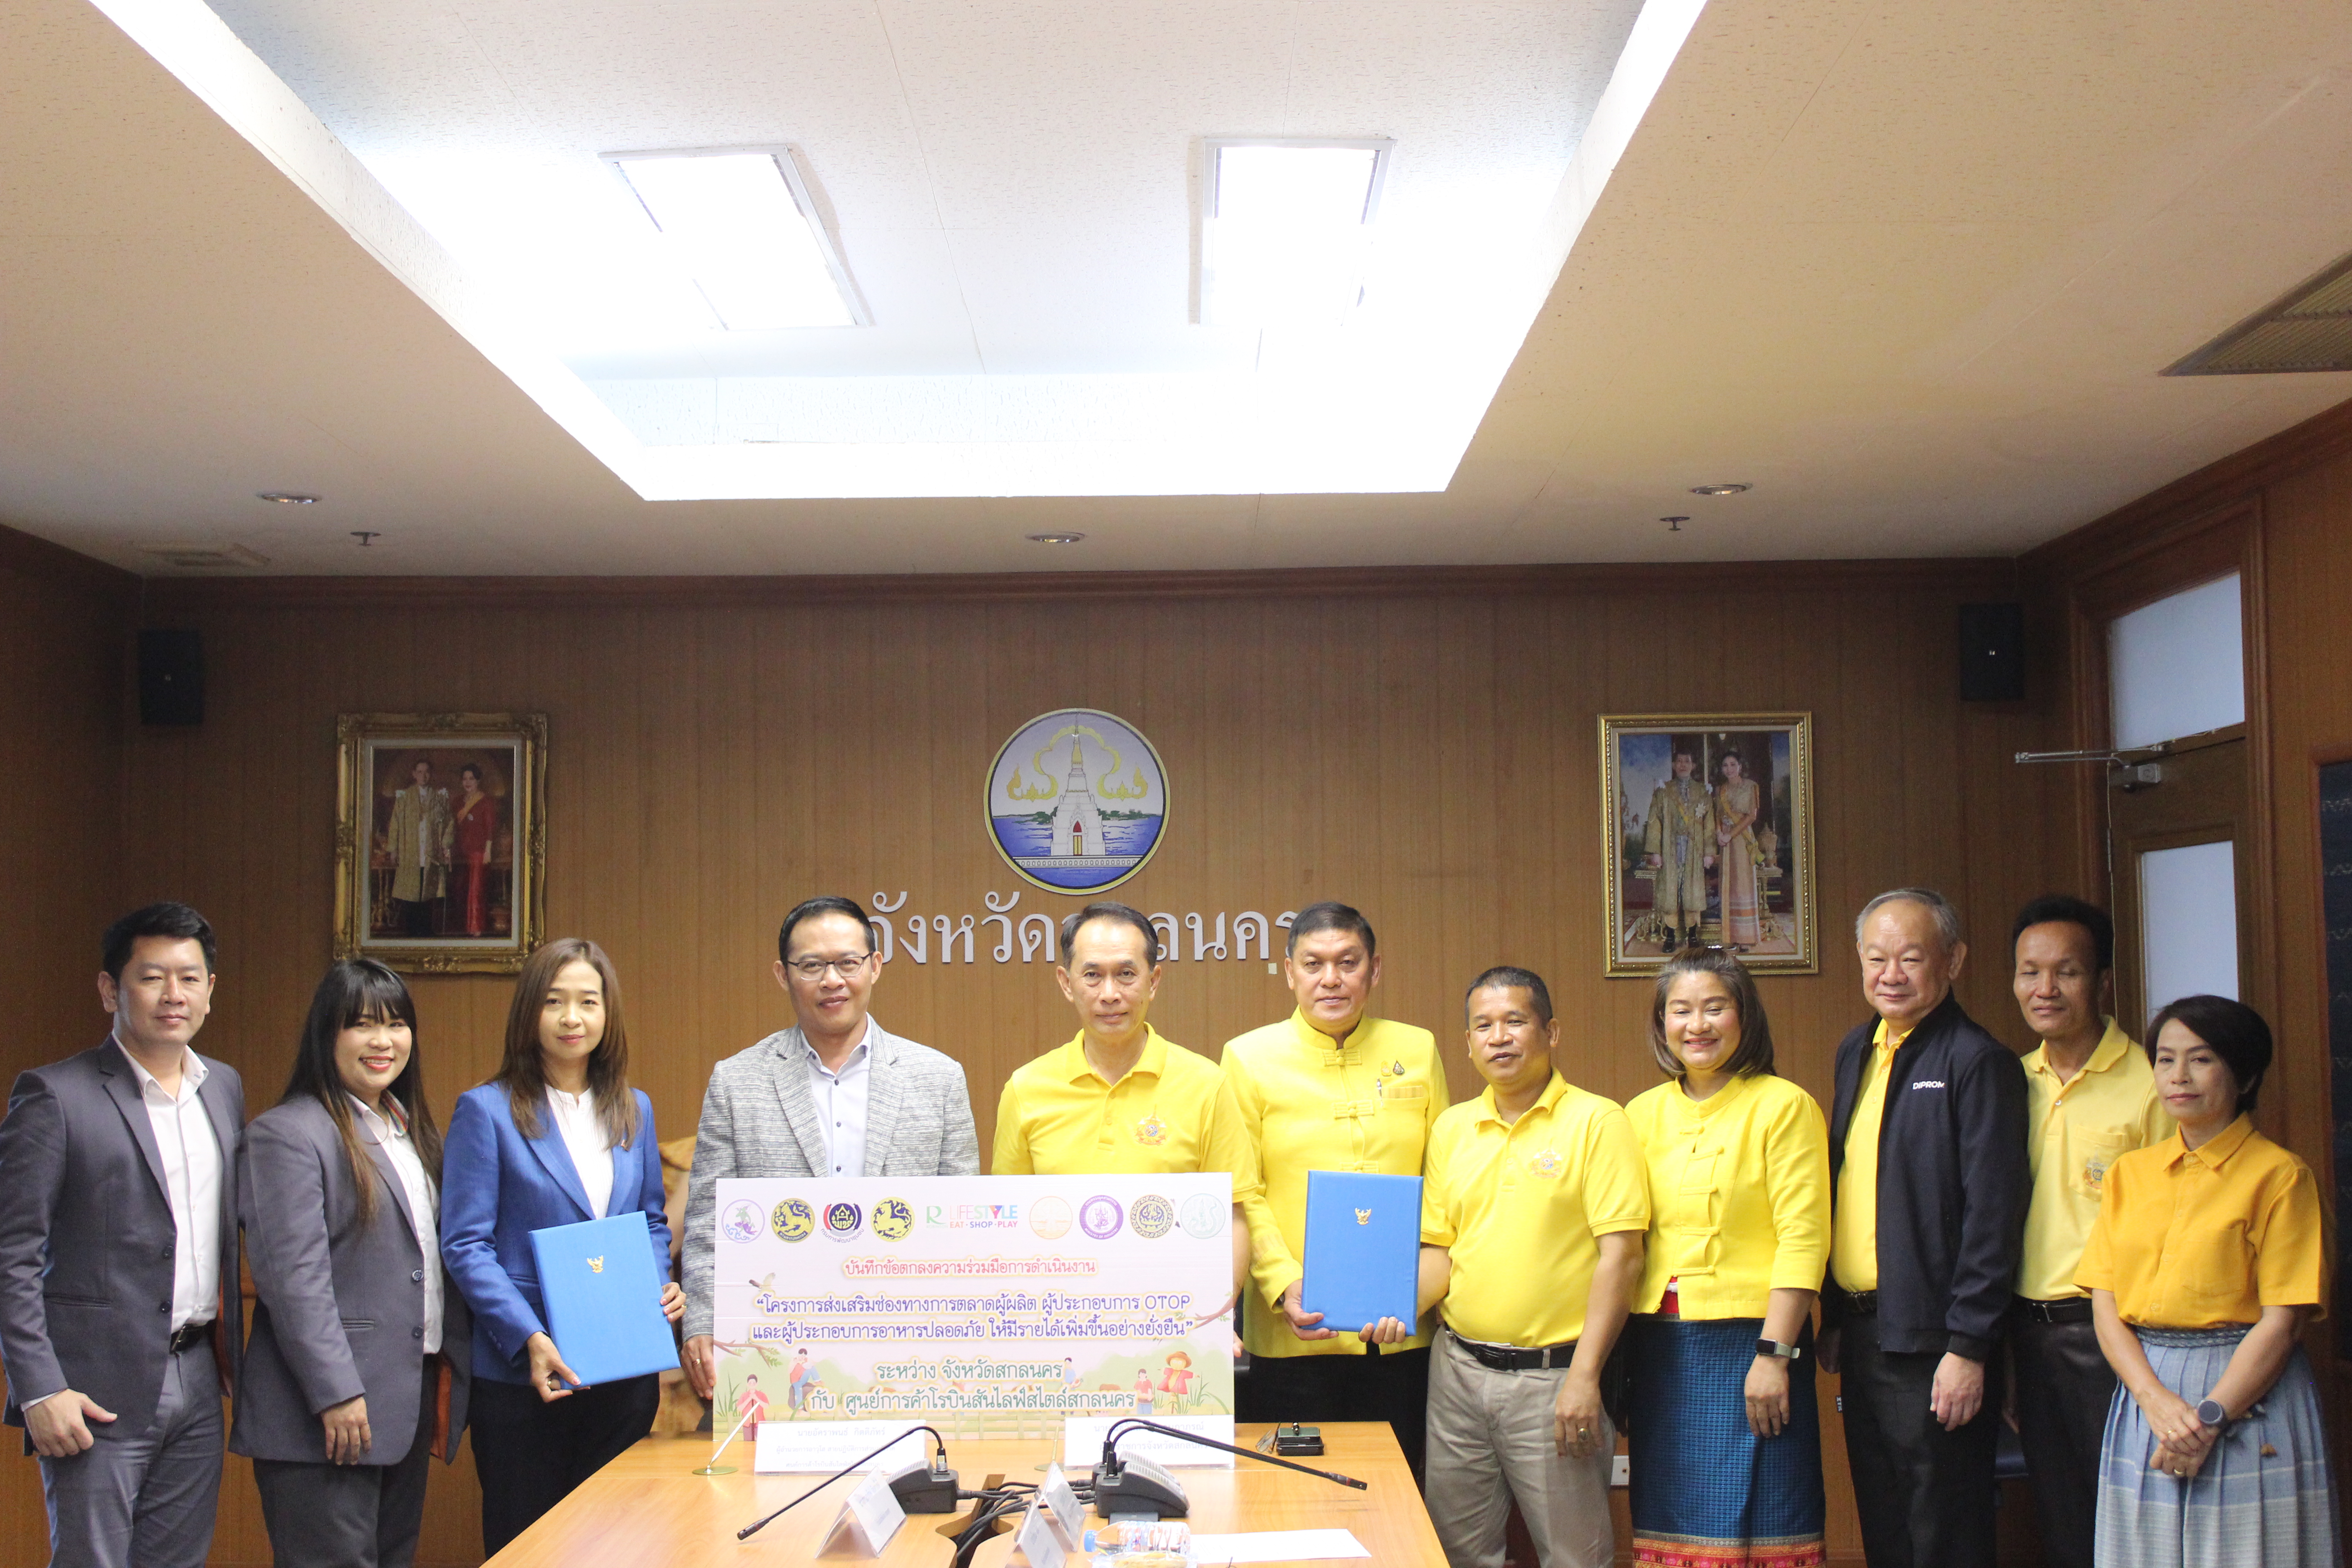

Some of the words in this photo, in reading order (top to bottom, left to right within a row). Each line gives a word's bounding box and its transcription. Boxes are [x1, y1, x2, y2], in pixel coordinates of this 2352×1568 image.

[1912, 1080, 1945, 1090] DIPROM
[950, 1205, 1018, 1220] LIFESTYLE
[845, 1257, 1095, 1275] บันทึกข้อตกลงความร่วมมือการดำเนินงาน
[1042, 1293, 1140, 1316] ผู้ประกอบการ
[1145, 1295, 1191, 1310] OTOP
[753, 1320, 985, 1344] และผู้ประกอบการอาหารปลอดภัย
[877, 1360, 936, 1380] ระหว่าง
[941, 1360, 1062, 1380] จังหวัดสกลนคร
[810, 1389, 835, 1410] กับ
[846, 1386, 1135, 1415] ศูนย์การค้าโรบินสันไลฟ์สไตล์สกลนคร
